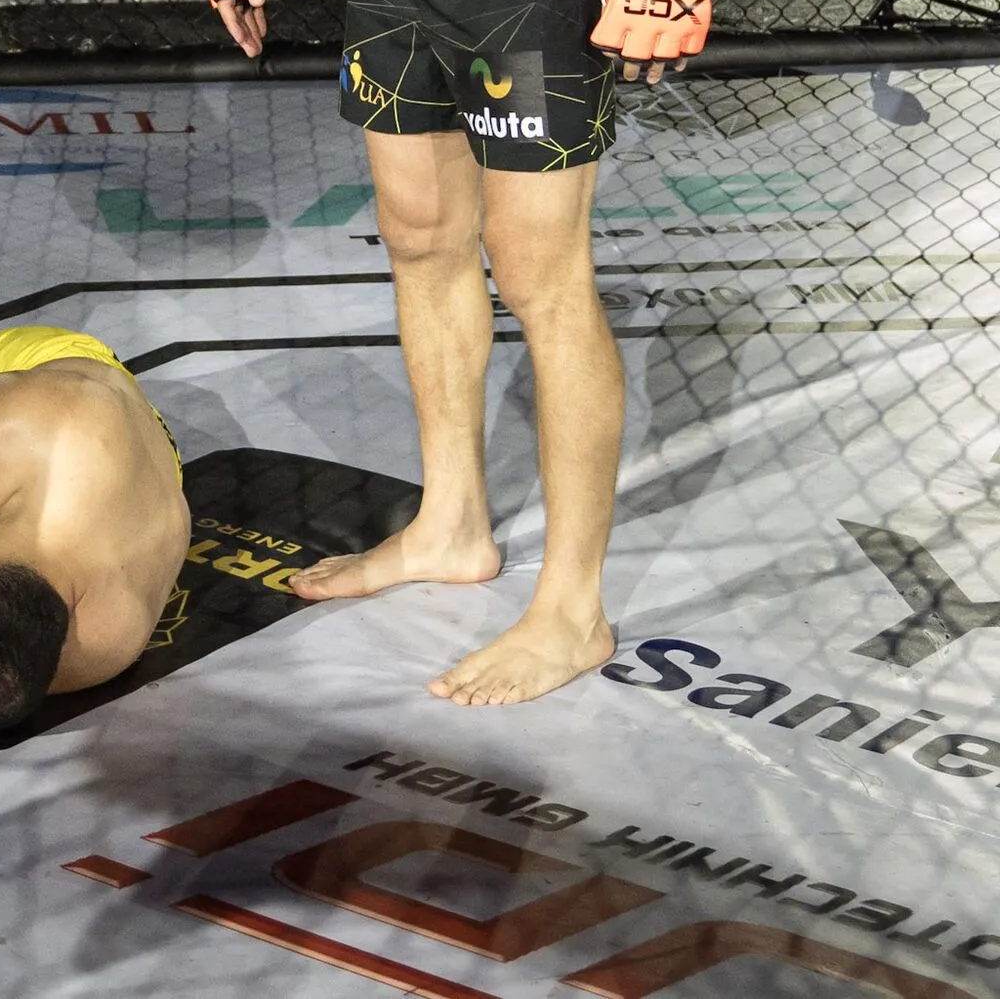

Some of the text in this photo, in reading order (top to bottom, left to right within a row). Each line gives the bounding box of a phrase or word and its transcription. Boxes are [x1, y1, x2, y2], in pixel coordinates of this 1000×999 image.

[192, 514, 302, 555] ENERG
[601, 638, 1000, 787] Sanie
[344, 750, 588, 832] GMBH
